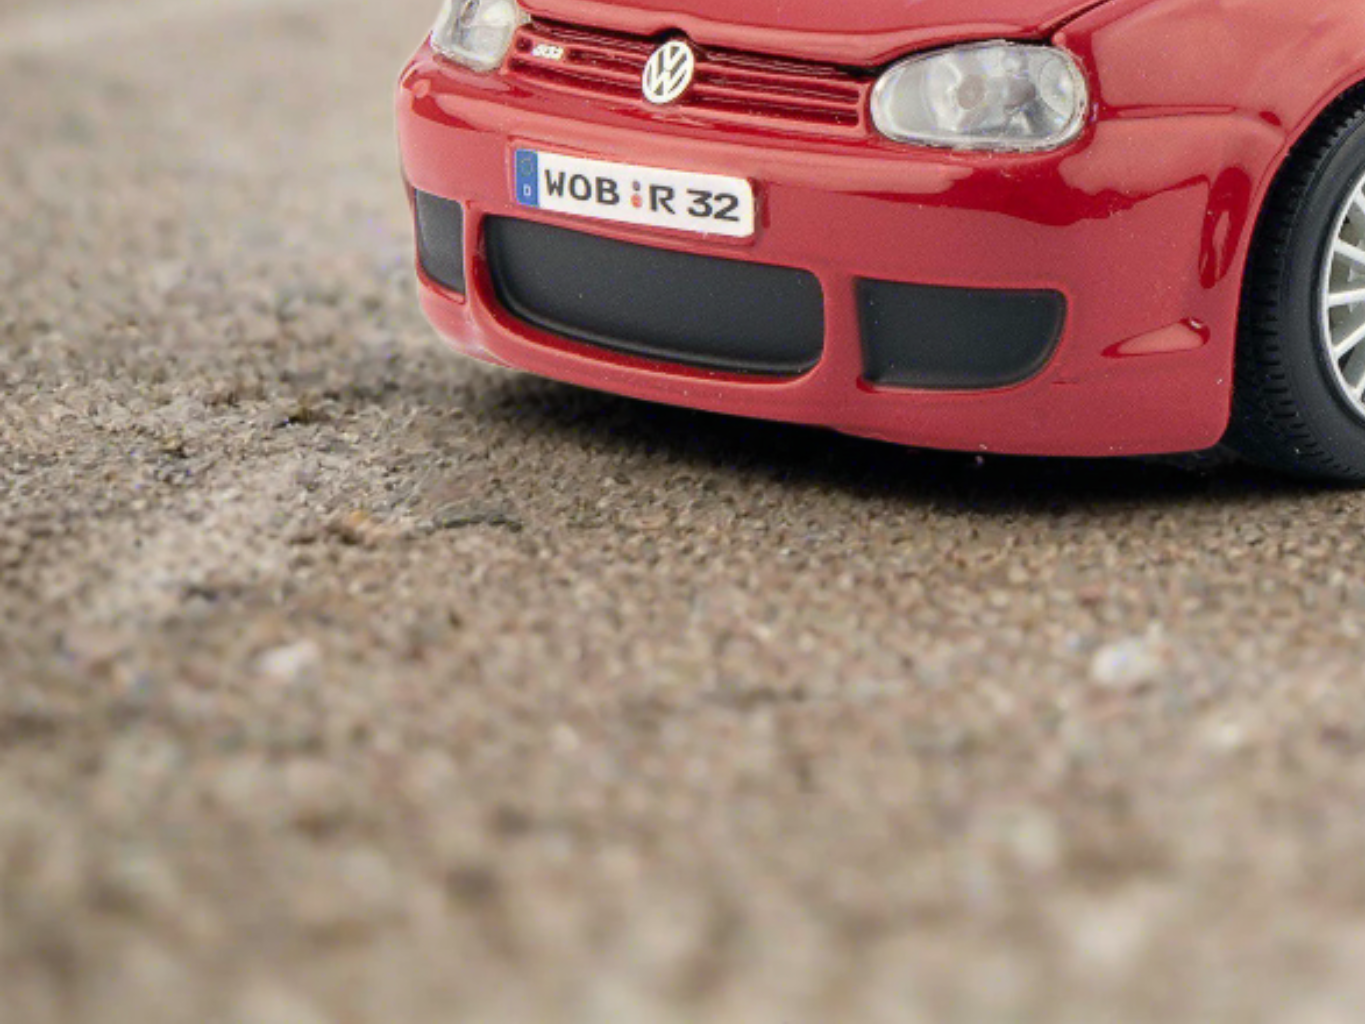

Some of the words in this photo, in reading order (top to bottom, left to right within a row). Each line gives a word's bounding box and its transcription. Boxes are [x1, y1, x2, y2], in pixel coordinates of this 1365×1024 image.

[544, 169, 620, 206] WOB
[649, 184, 676, 215] R
[687, 189, 740, 222] 32
